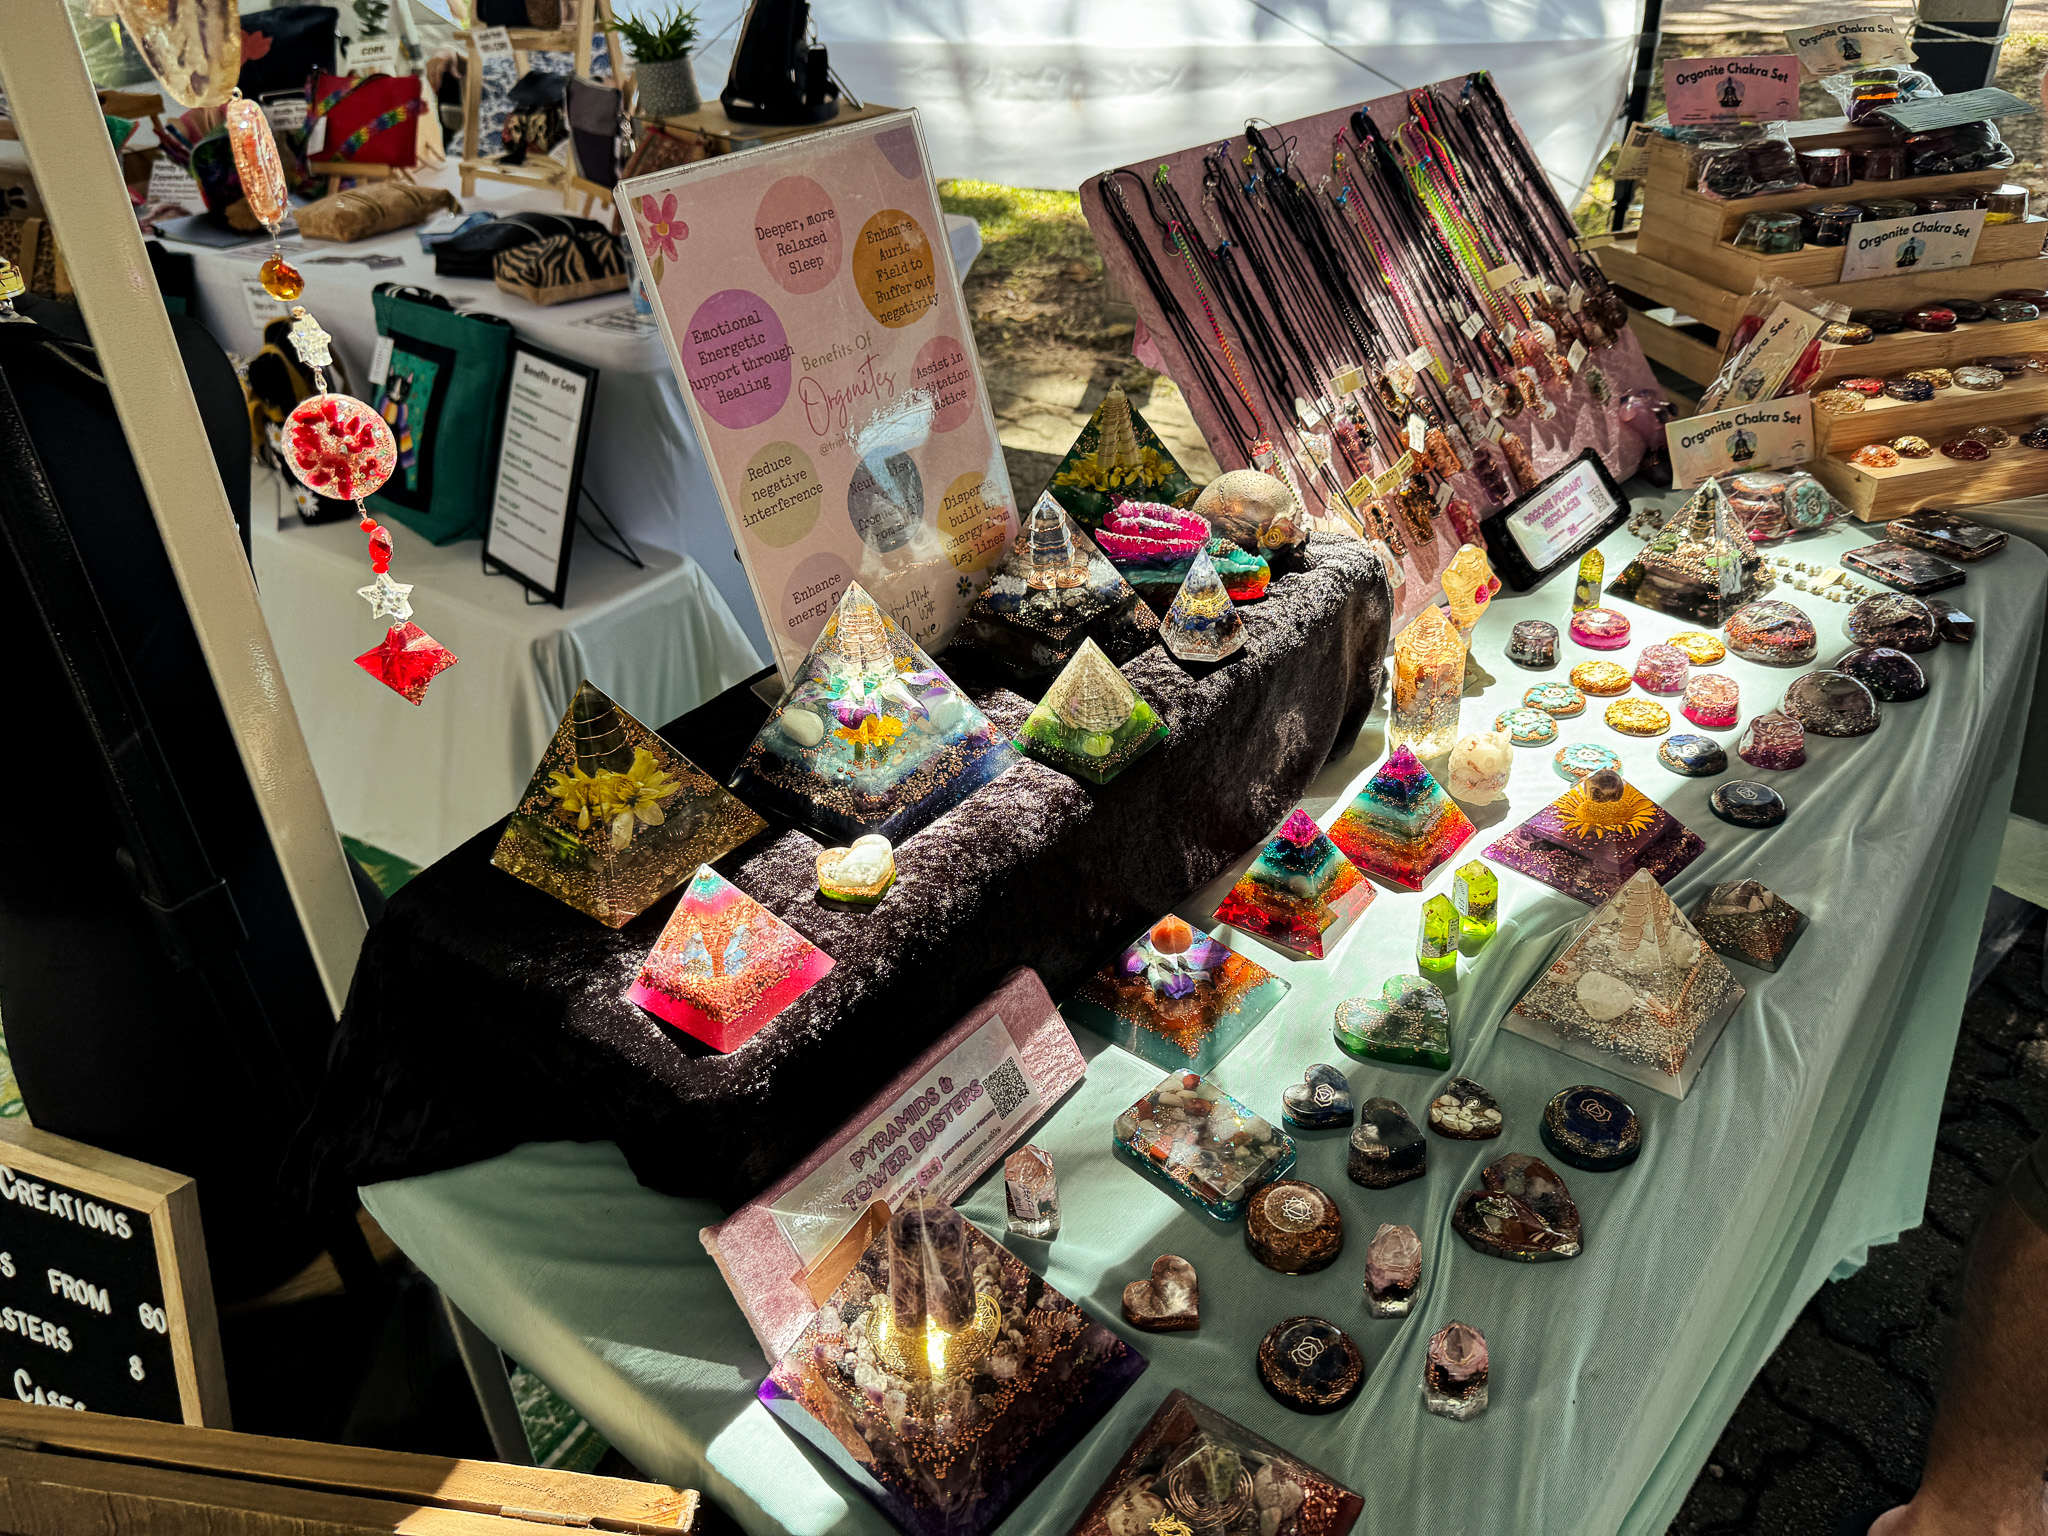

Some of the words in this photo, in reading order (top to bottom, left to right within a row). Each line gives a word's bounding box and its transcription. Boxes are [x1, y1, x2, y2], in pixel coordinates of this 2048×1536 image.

[1799, 28, 1837, 48] Orgonite
[1837, 24, 1875, 34] Chakra
[1876, 24, 1895, 34] Set
[1676, 64, 1725, 86] Orgonite
[1727, 61, 1769, 77] Chakra
[1770, 67, 1789, 83] Set
[755, 218, 805, 241] Deeper,
[807, 208, 835, 226] more
[865, 221, 913, 244] Enhance
[1858, 226, 1909, 250] Orgonite
[1912, 221, 1951, 234] Chakra
[1952, 223, 1971, 237] Set
[776, 230, 828, 257] Relaxed
[879, 242, 911, 261] Auric
[788, 256, 825, 275] Sleep
[875, 261, 909, 283] Field
[910, 258, 923, 270] to
[875, 285, 912, 304] Buffer
[914, 273, 934, 289] out
[879, 293, 939, 323] negativity
[691, 310, 763, 344] Emotional
[1769, 317, 1792, 336] Set
[697, 333, 767, 365] Energetic
[741, 343, 795, 372] through
[801, 343, 853, 371] Benefits
[855, 331, 872, 350] Of
[916, 356, 949, 379] Assist
[950, 352, 964, 365] in
[716, 376, 772, 404] Healing
[798, 354, 896, 436] Orgonites
[1681, 420, 1733, 449] Orgonite
[1735, 411, 1780, 426] Chakra
[1782, 411, 1802, 424] Set
[747, 455, 793, 482] Reduce
[751, 469, 808, 502] negative
[943, 479, 993, 510] Disperse
[742, 482, 824, 528] interference
[948, 504, 981, 528] built
[946, 523, 983, 551] energy
[984, 510, 1011, 530] from
[953, 549, 973, 567] Ley
[974, 532, 1006, 556] lines
[792, 573, 842, 605] Enhance
[788, 600, 828, 628] energy
[849, 1087, 940, 1172] PYRAMIDS
[938, 1076, 954, 1094] &
[841, 1145, 912, 1211] TOWER
[908, 1079, 984, 1153] BUSTERS
[0, 1164, 132, 1239] CREATIONS
[47, 1268, 111, 1315] FROM
[128, 1354, 146, 1381] 8
